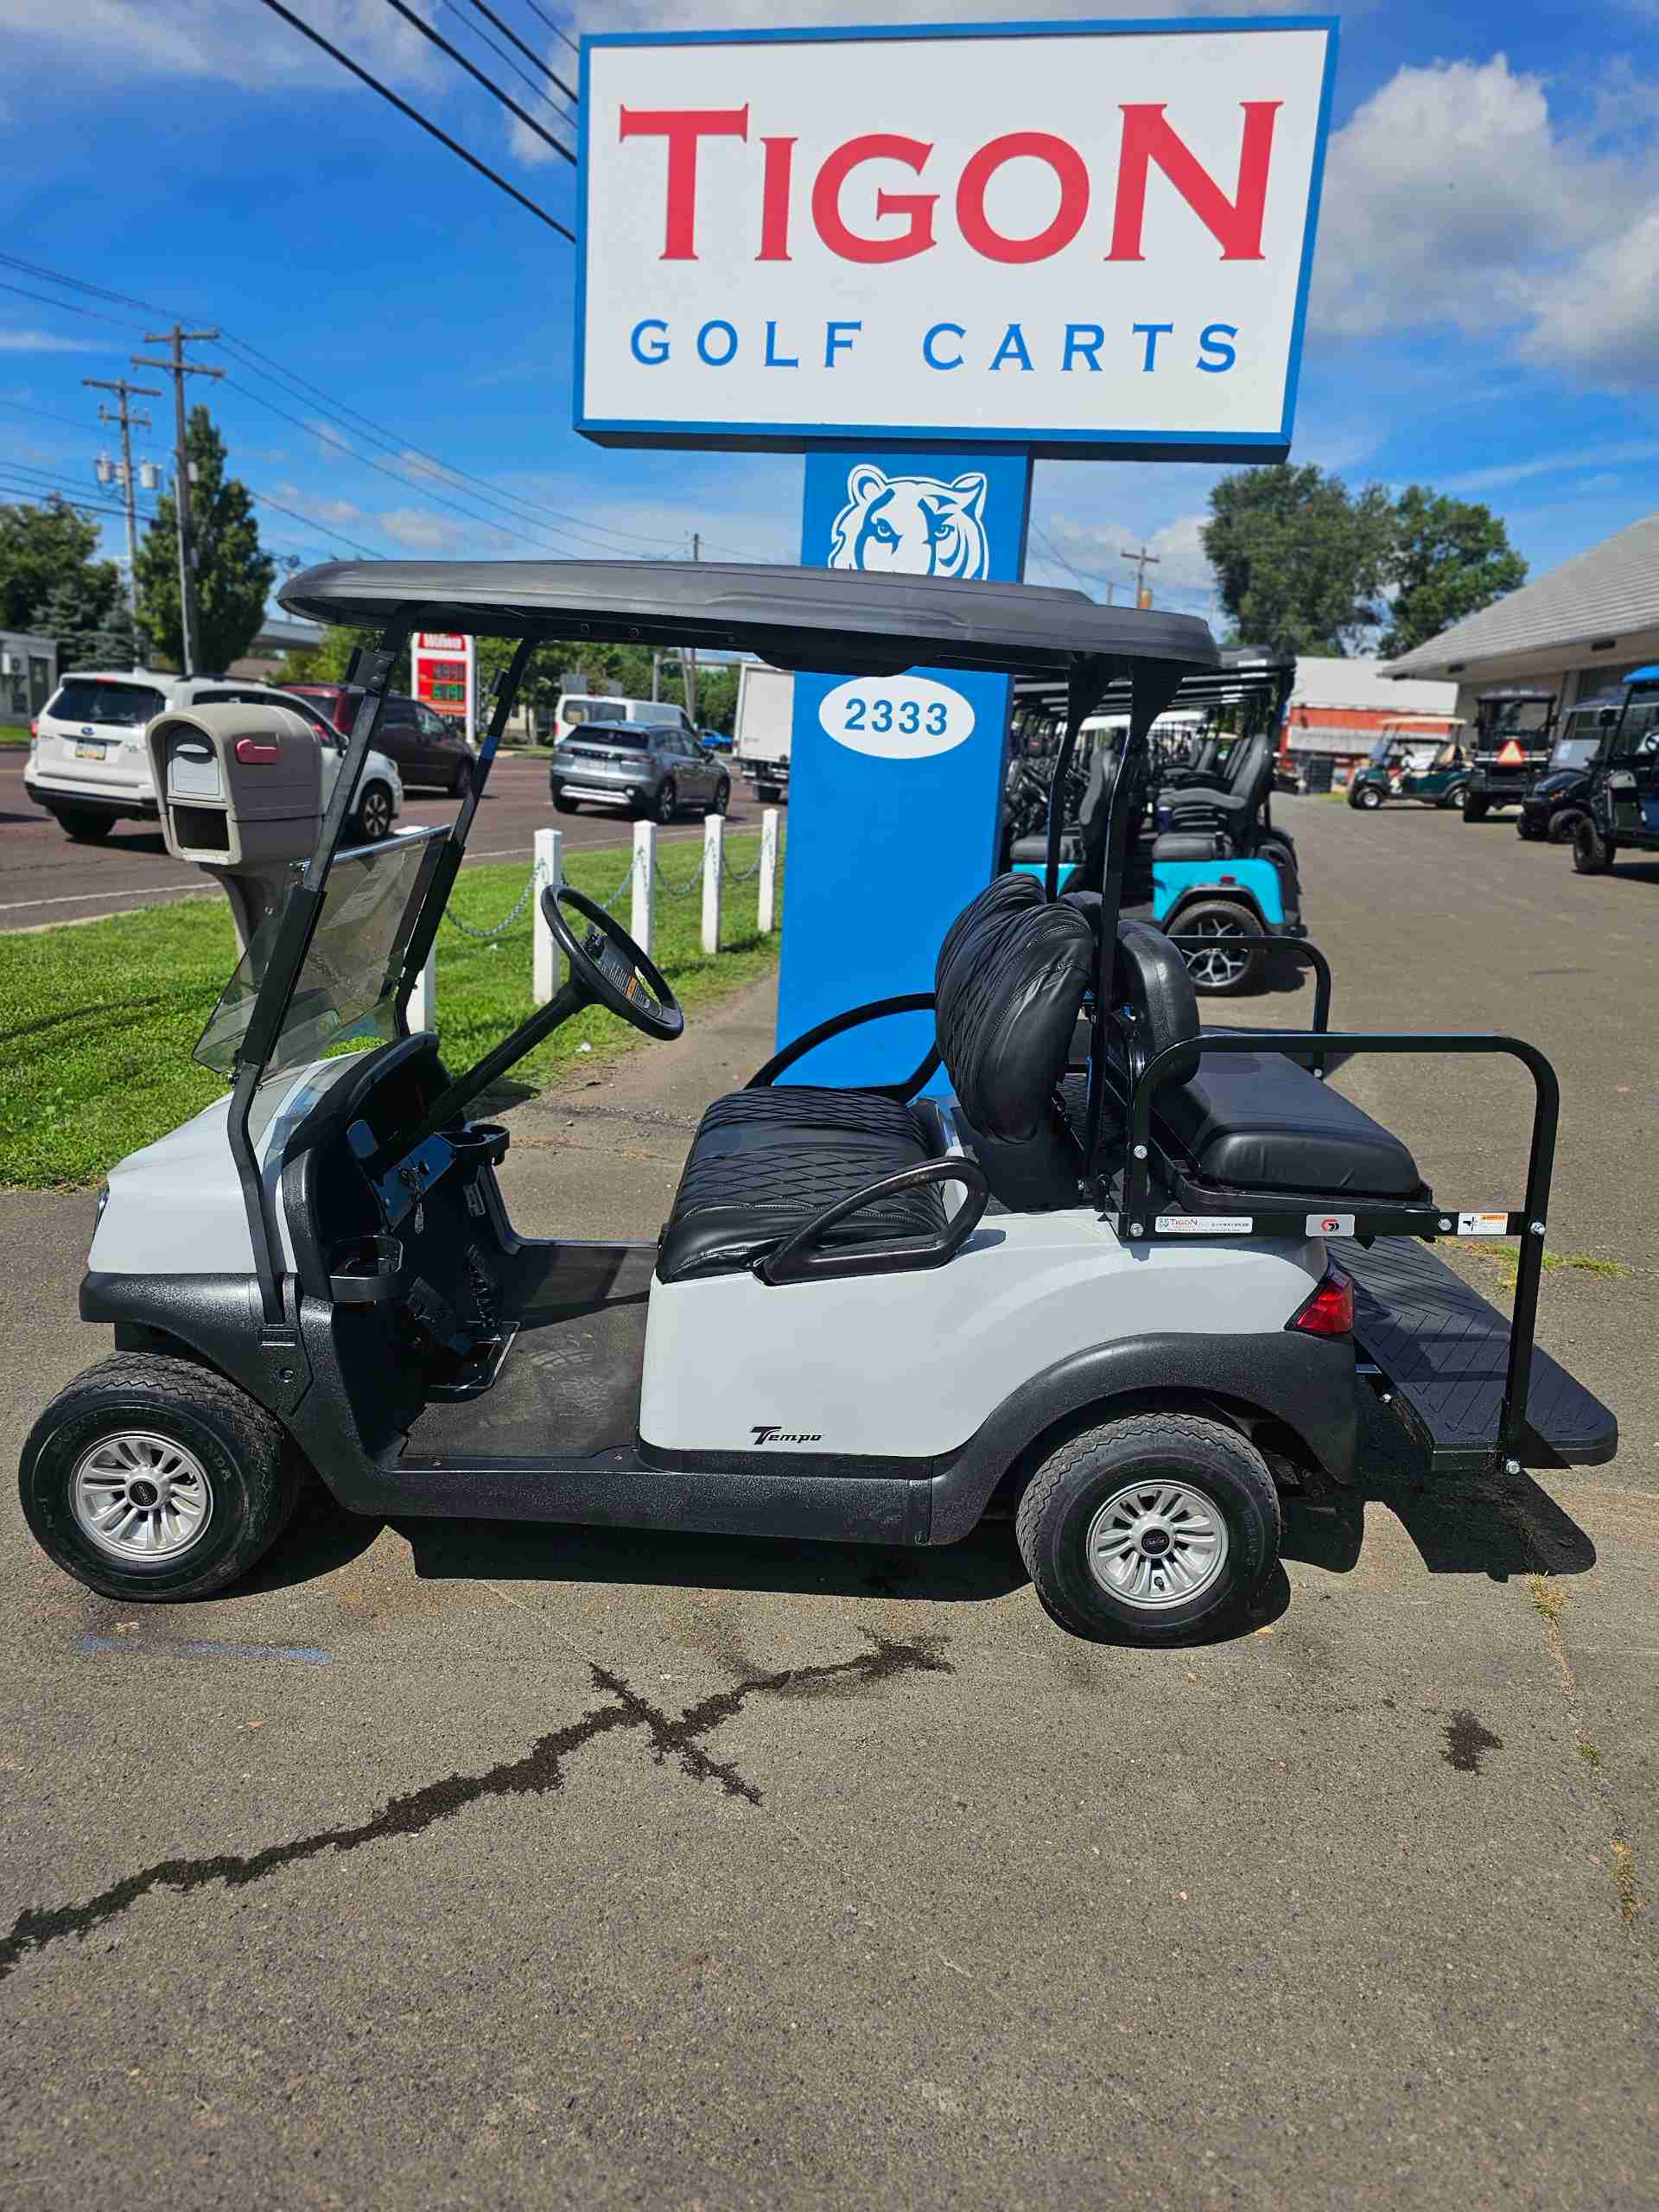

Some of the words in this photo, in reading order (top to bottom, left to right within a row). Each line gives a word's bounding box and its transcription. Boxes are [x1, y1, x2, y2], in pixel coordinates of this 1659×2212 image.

[619, 100, 1284, 264] TIGON
[630, 319, 862, 369] GOLF
[922, 321, 1239, 373] CARTS
[843, 697, 948, 736] 2333
[750, 1426, 823, 1446] Tempo
